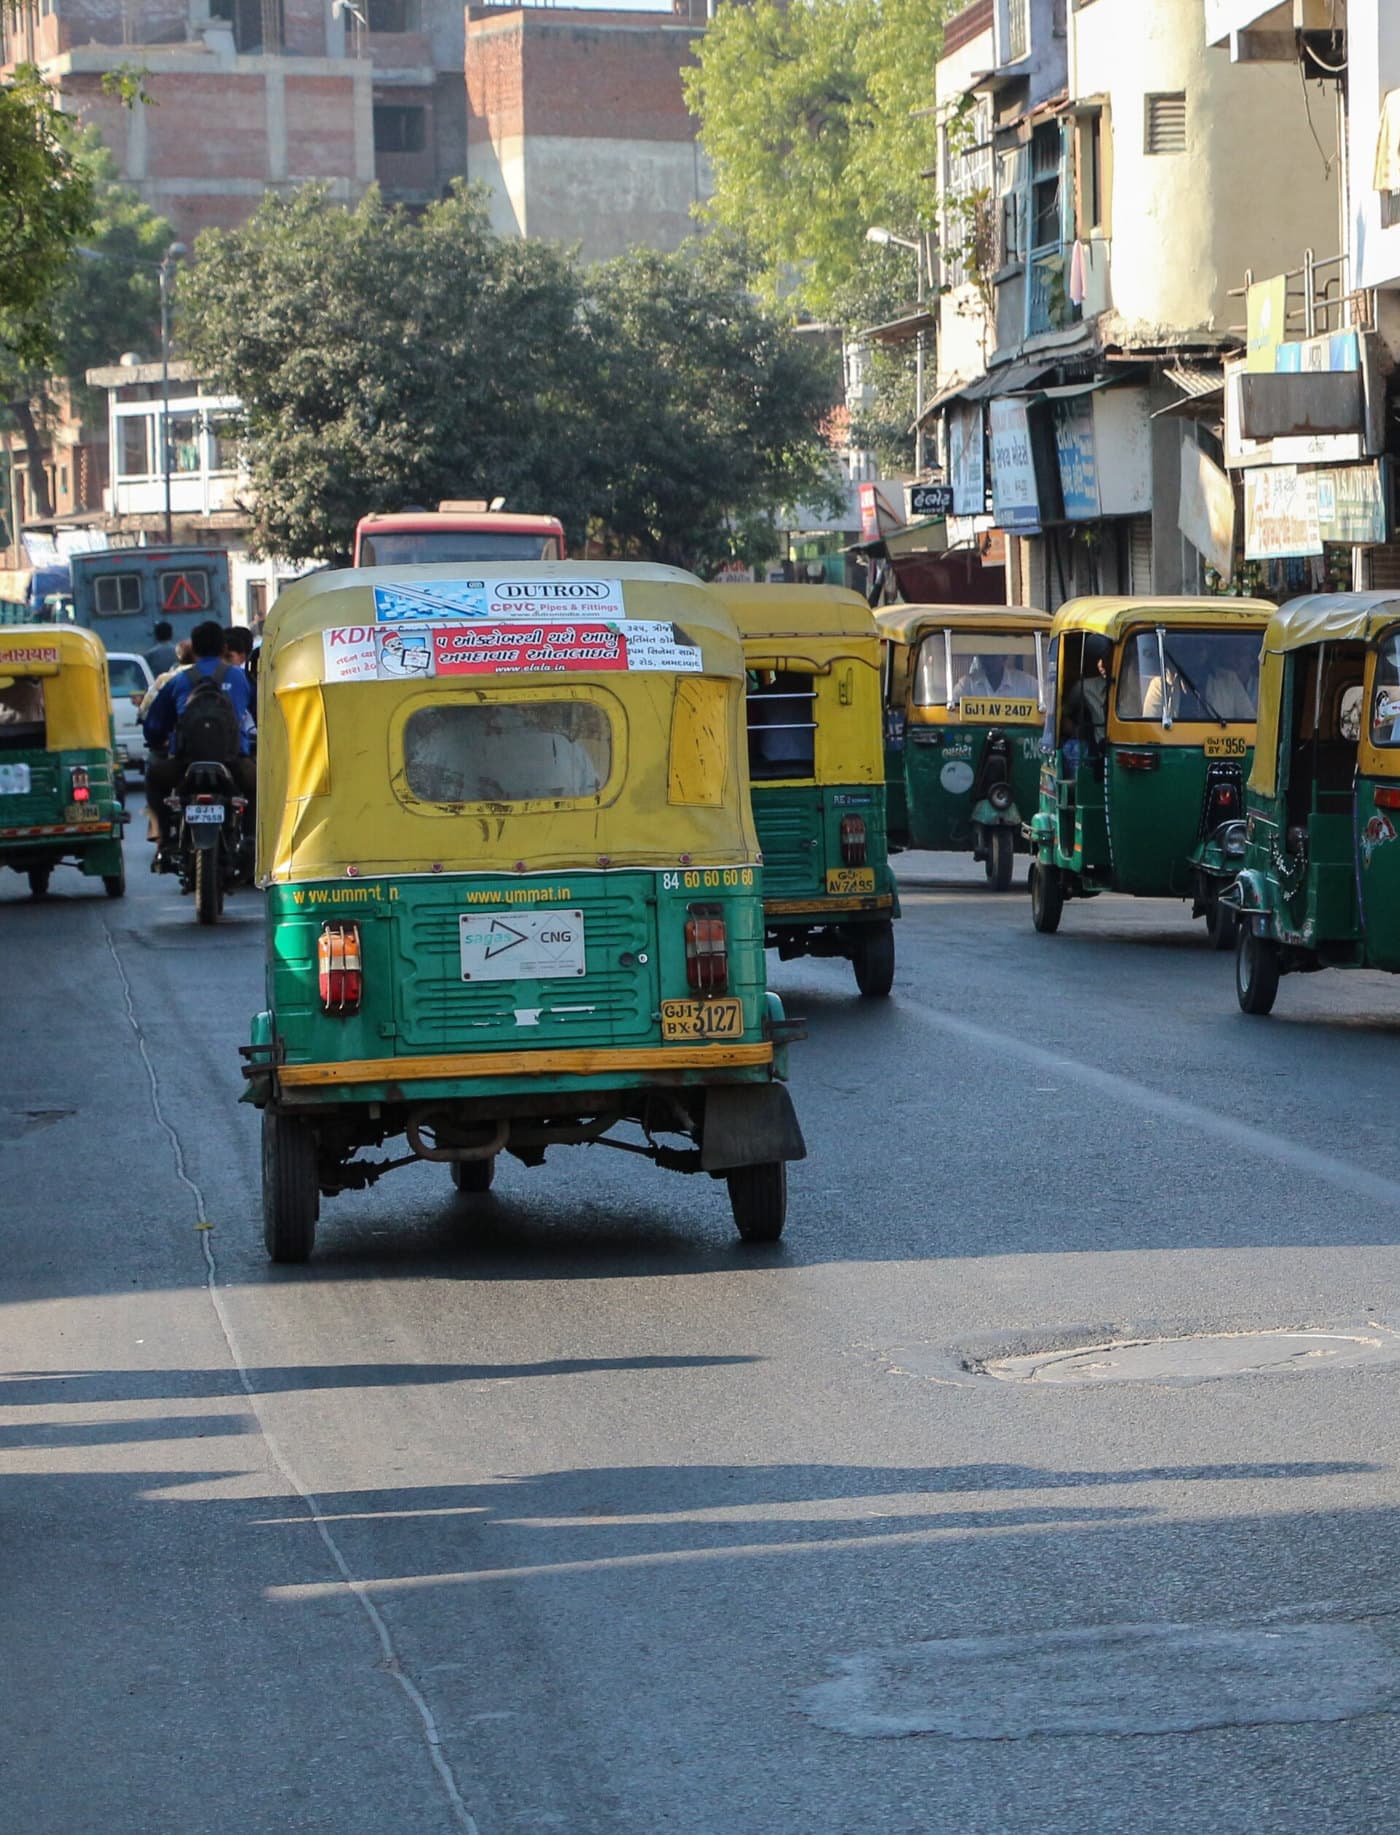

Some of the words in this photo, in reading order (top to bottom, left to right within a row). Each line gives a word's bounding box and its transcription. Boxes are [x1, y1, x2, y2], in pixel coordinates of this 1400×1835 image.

[507, 585, 600, 597] DUTRON
[490, 603, 536, 612] CPVC
[540, 603, 568, 612] Pipes
[581, 603, 619, 612] Fittings
[439, 650, 519, 664] અમદાવાદ
[495, 664, 566, 672] www.elala.in
[1005, 704, 1033, 716] 2407
[663, 872, 680, 889] 84
[684, 871, 700, 888] 60
[704, 870, 719, 887] 60
[723, 869, 738, 886] 60
[741, 868, 754, 885] 60
[467, 886, 571, 904] www.ummat.in
[540, 930, 572, 943] CNG
[692, 1005, 737, 1033] 3127
